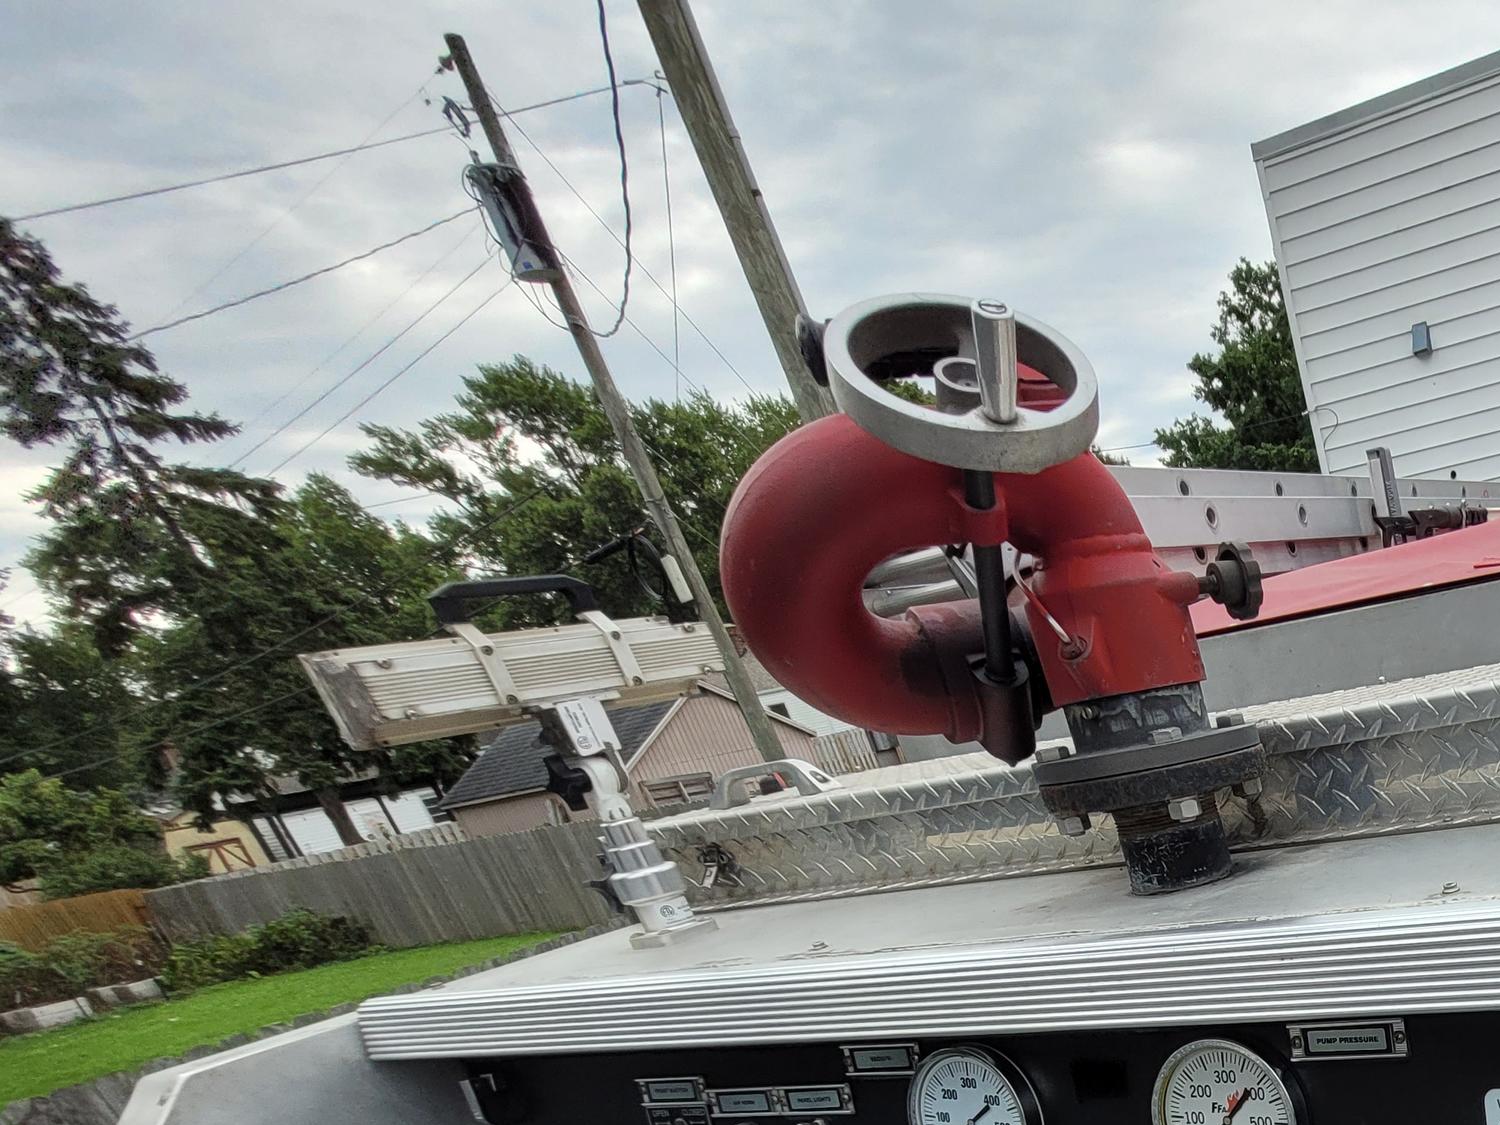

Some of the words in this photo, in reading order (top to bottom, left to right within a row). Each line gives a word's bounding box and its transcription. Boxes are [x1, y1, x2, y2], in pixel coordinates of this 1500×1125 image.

[1317, 1037, 1337, 1045] PUMP
[1339, 1036, 1379, 1044] PRESSURE
[1214, 1070, 1236, 1084] 300
[960, 1077, 976, 1089] 300
[942, 1089, 957, 1100] 200
[1190, 1084, 1212, 1098] 200
[984, 1095, 1000, 1106] 400
[936, 1112, 950, 1122] 100
[1185, 1112, 1205, 1124] 100
